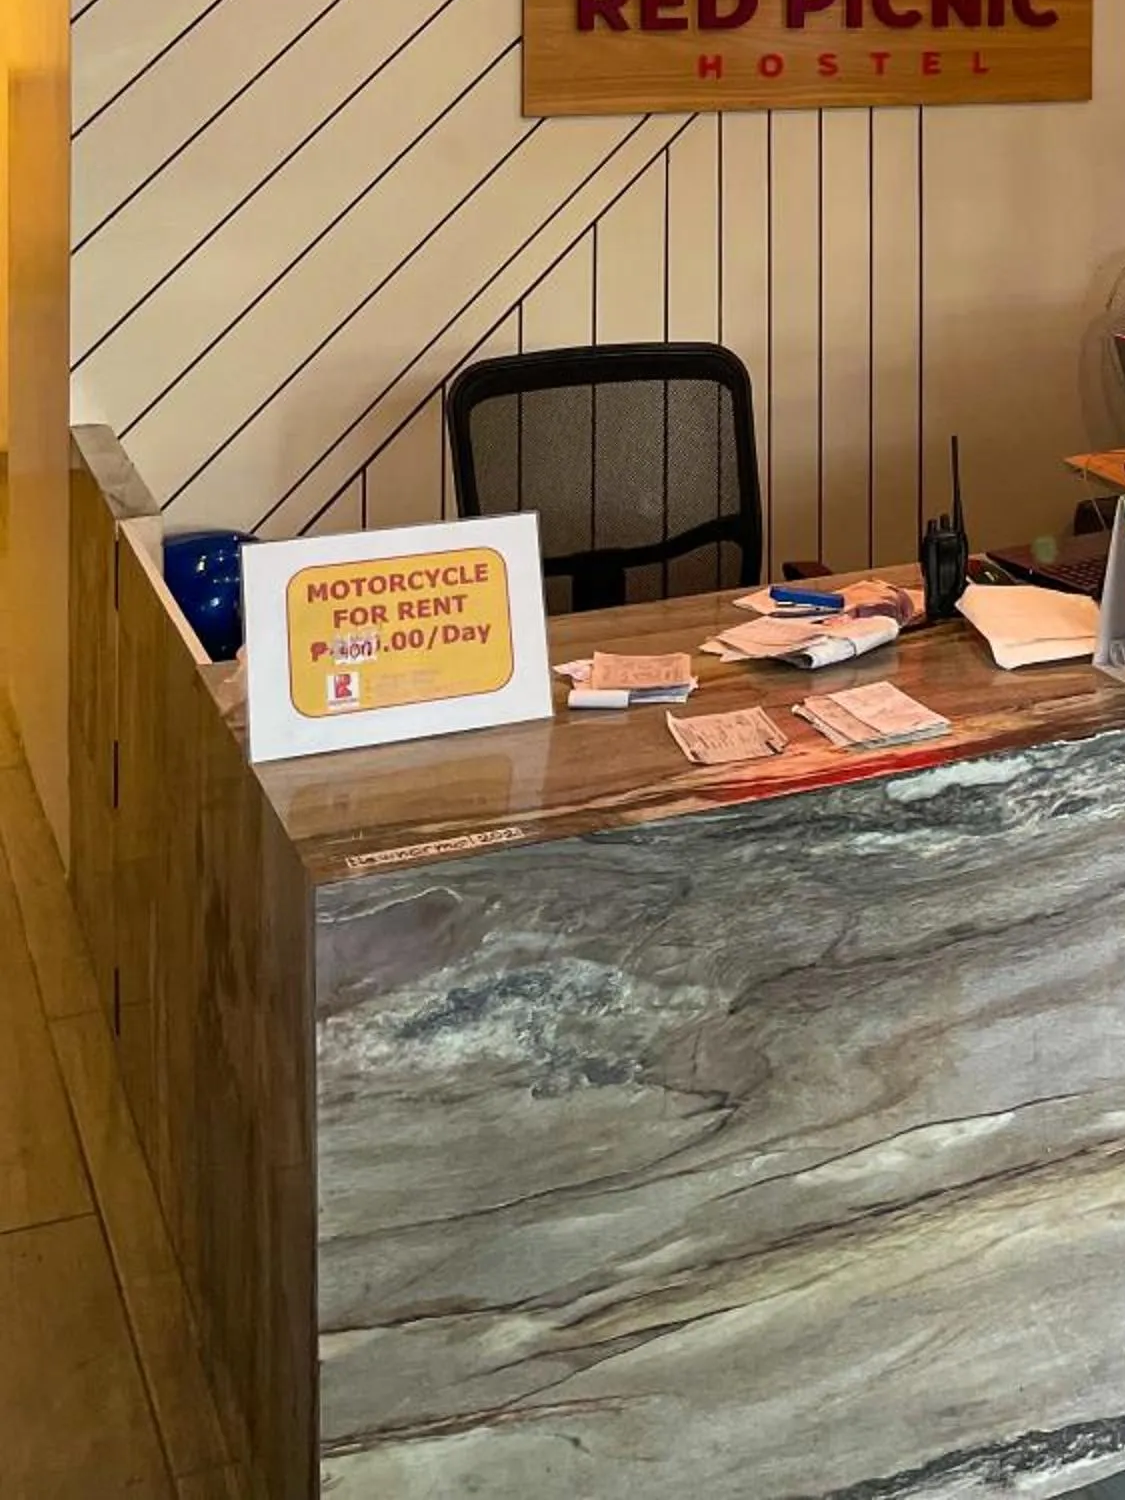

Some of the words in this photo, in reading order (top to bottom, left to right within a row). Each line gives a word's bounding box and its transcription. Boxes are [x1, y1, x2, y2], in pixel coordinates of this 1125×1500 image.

[699, 51, 991, 78] HOSTEL
[307, 563, 489, 604] MOTORCYCLE
[333, 605, 388, 629] FOR
[398, 595, 468, 621] RENT
